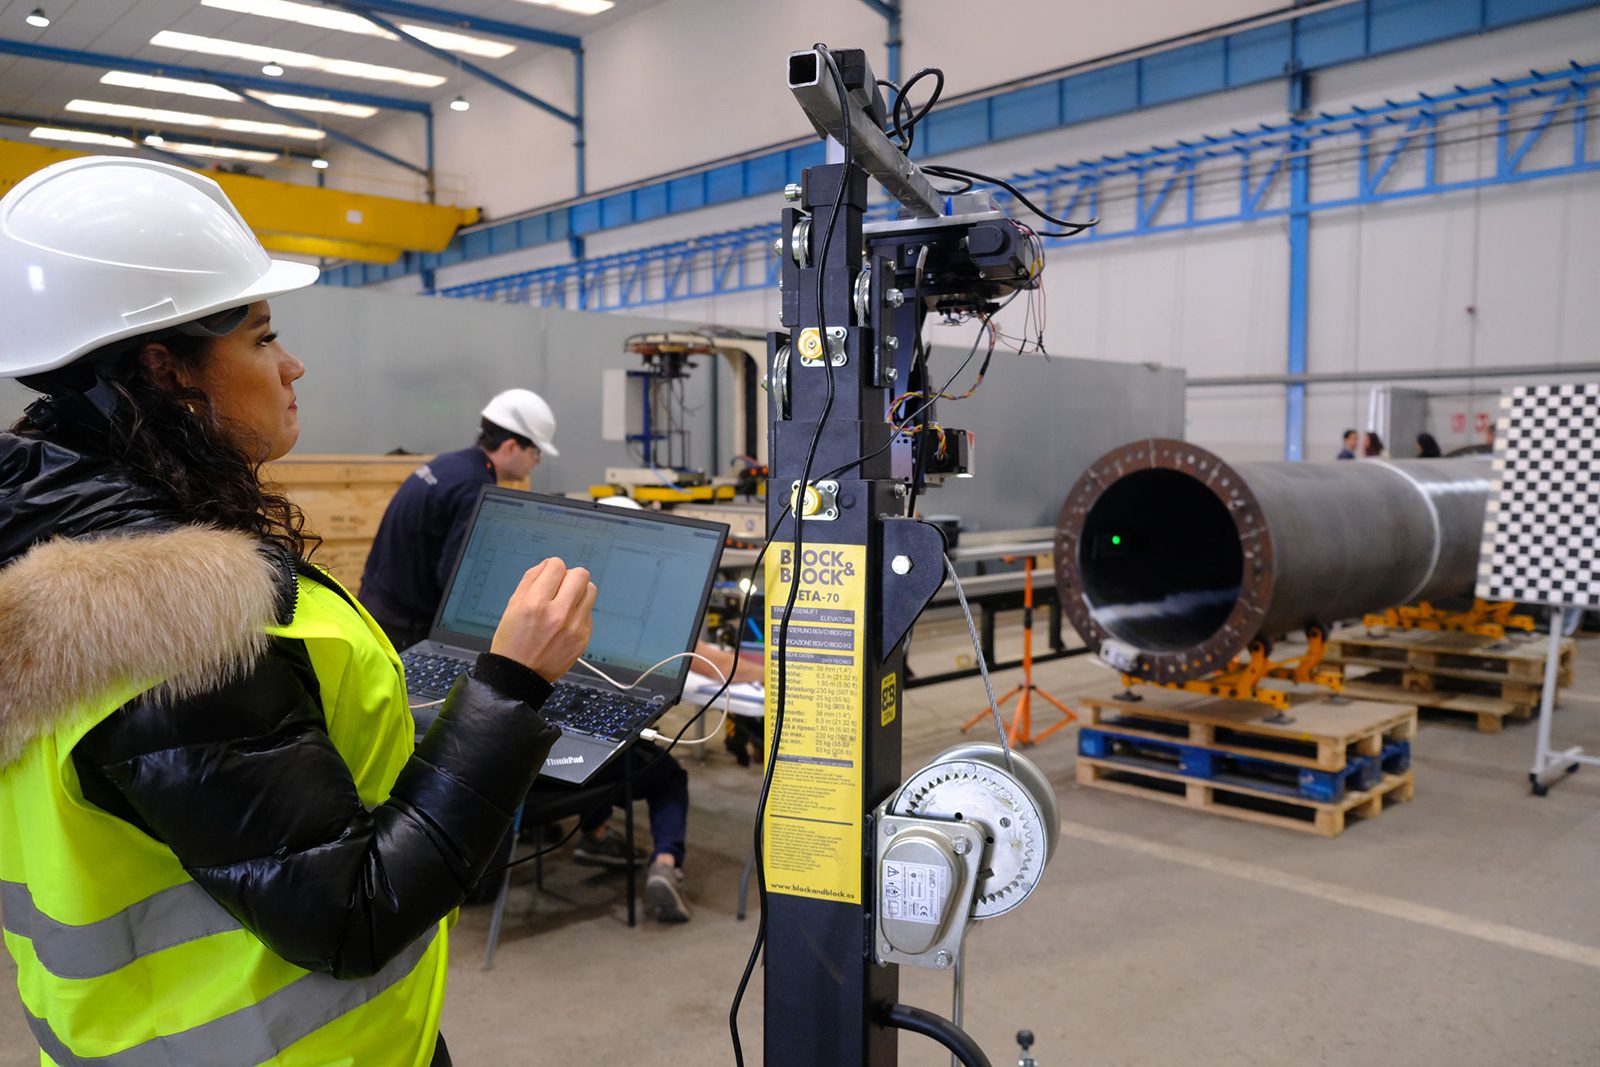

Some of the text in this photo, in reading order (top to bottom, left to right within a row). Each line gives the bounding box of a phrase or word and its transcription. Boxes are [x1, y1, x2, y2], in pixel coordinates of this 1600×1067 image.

[781, 549, 855, 576] BOCK &
[781, 567, 844, 585] BOCK
[797, 590, 840, 602] ETA-70
[546, 756, 584, 766] ThinkPad
[770, 883, 855, 898] www.blockandblock.es
